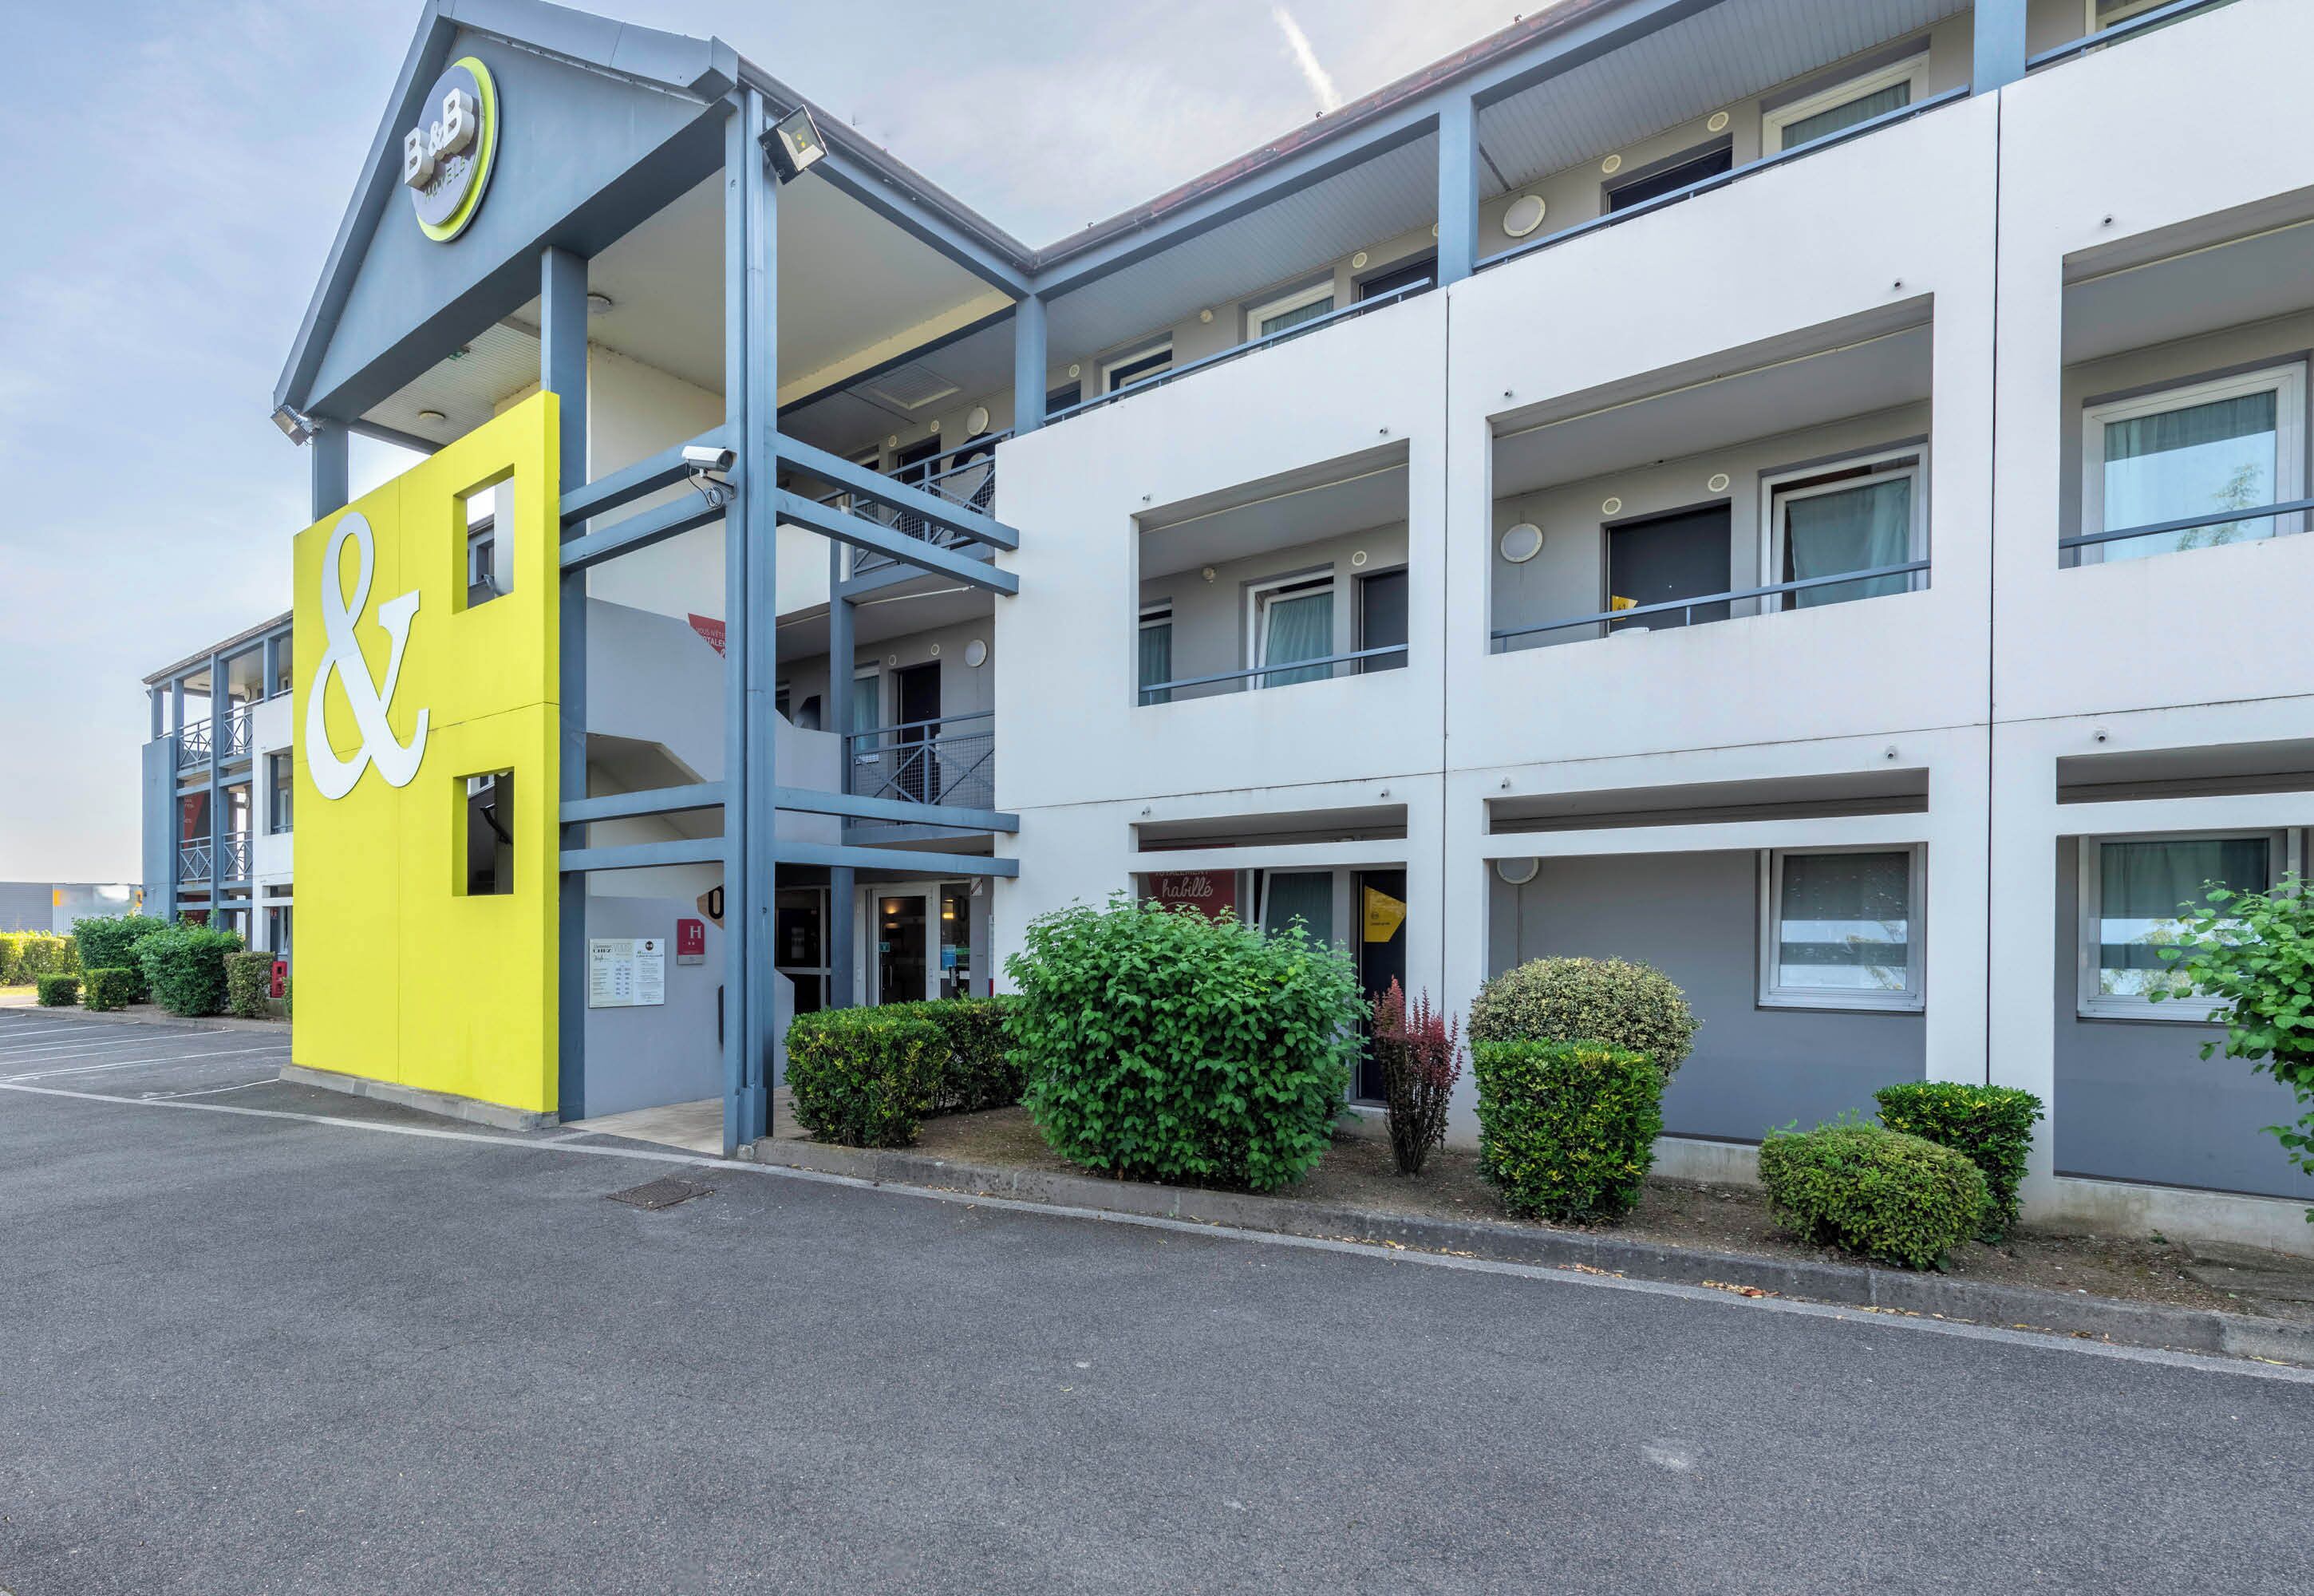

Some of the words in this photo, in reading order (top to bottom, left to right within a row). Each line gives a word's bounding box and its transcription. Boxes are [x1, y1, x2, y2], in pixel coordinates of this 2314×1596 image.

[405, 88, 472, 188] B&B
[306, 512, 430, 800] &
[1162, 876, 1213, 898] habillé
[689, 926, 701, 938] H
